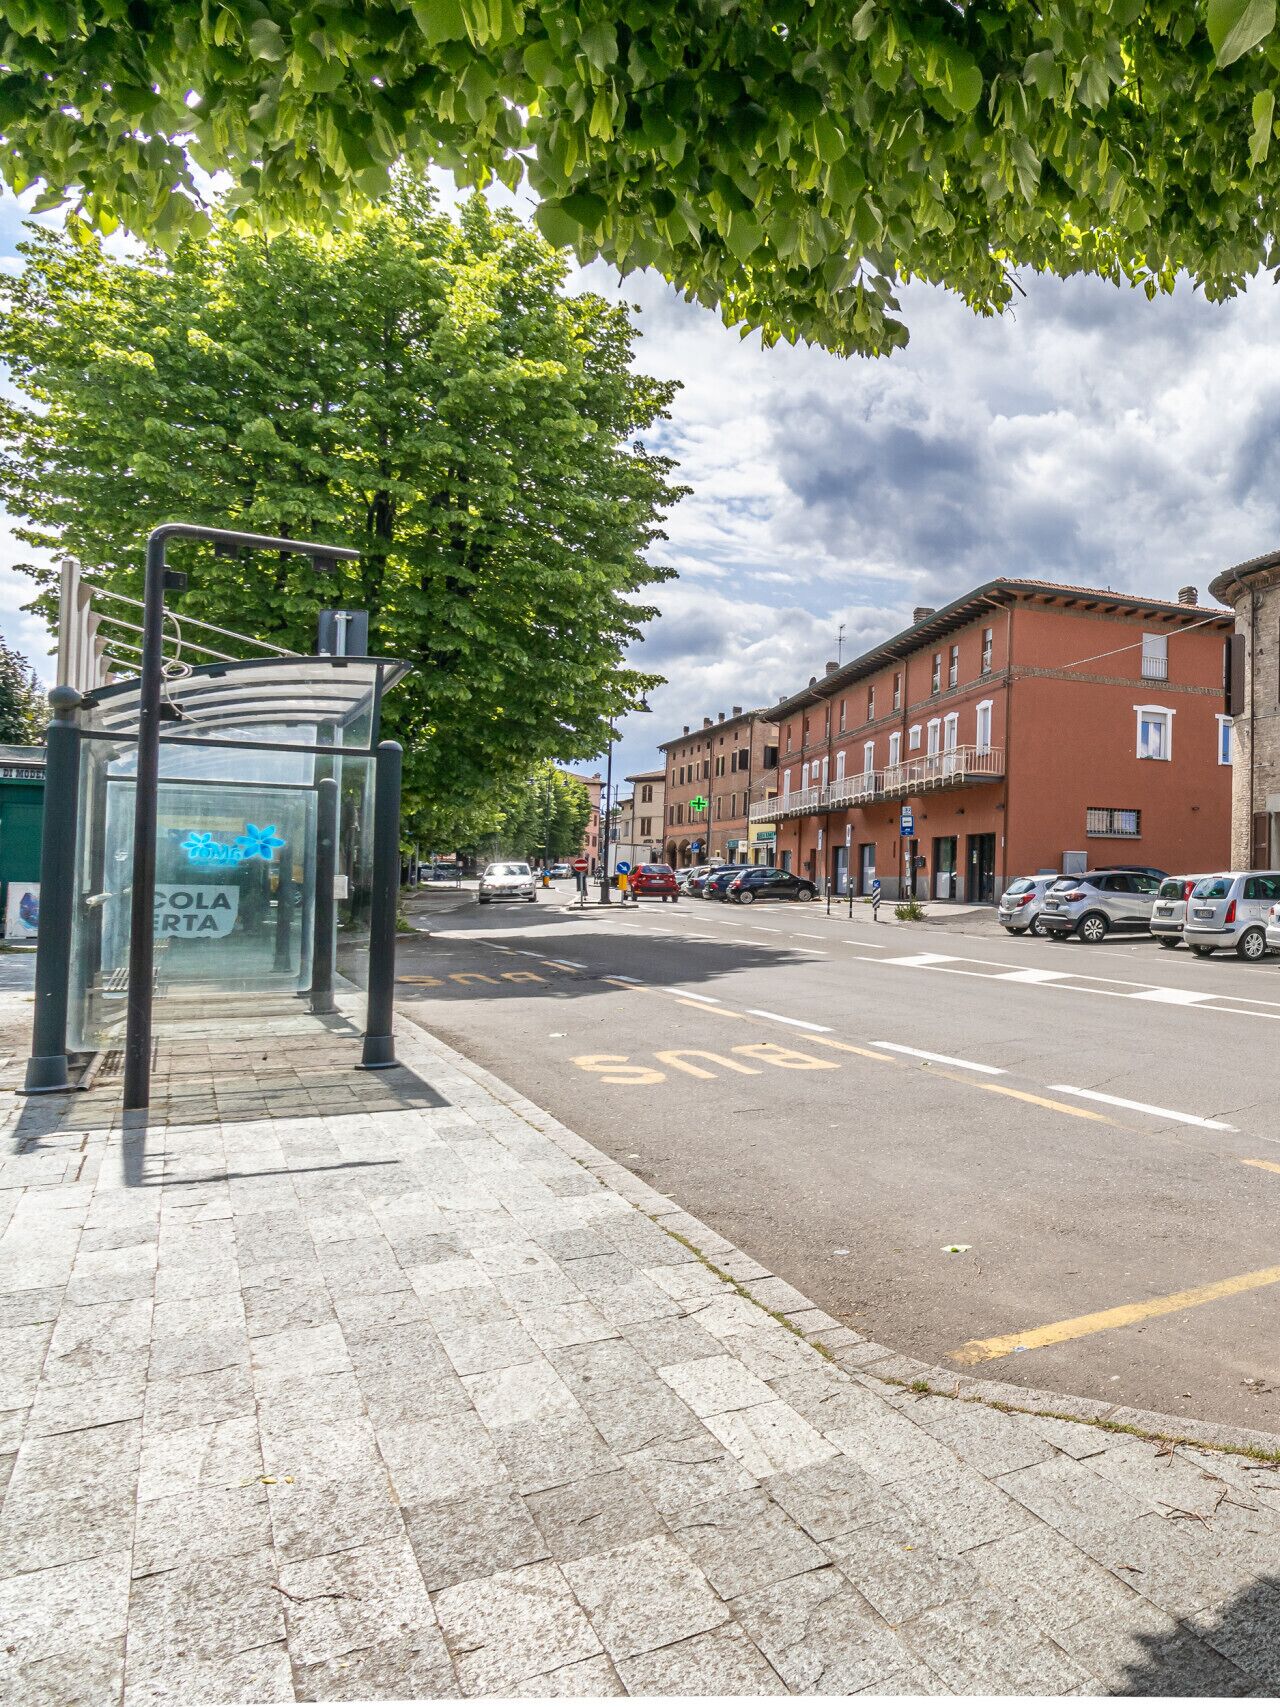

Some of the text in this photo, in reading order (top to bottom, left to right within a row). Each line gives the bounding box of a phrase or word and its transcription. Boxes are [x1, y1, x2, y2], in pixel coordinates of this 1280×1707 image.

[3, 768, 13, 778] DI
[394, 971, 551, 986] BUS
[569, 1042, 842, 1085] BUS
